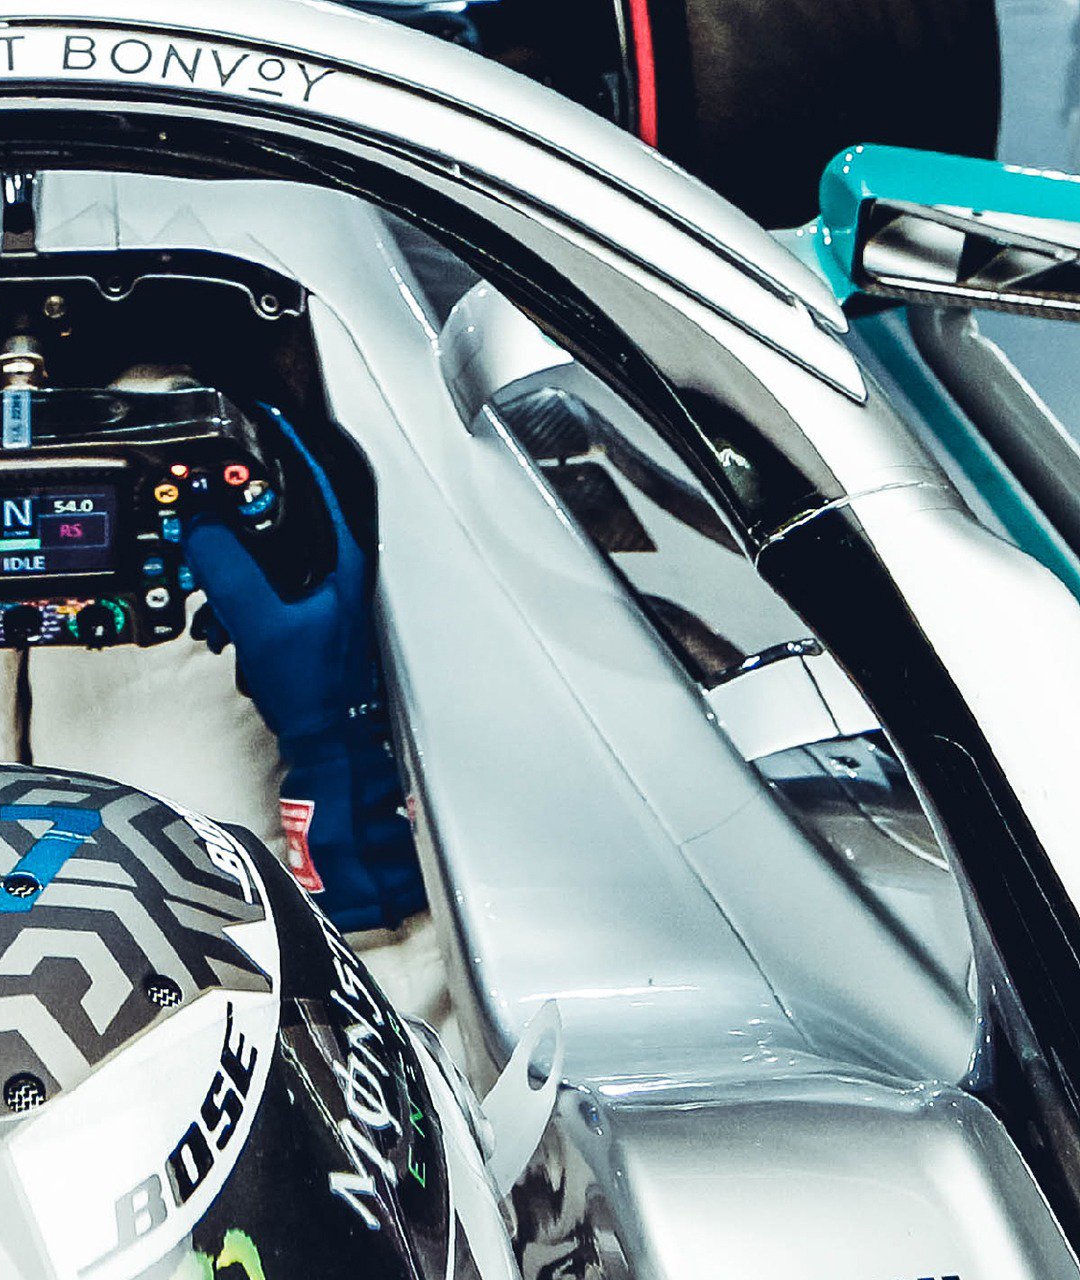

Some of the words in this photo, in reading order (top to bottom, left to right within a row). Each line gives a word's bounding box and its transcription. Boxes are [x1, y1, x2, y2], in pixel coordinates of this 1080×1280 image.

[3, 498, 33, 527] N
[53, 499, 94, 514] 54.0
[2, 555, 46, 571] IDLE
[76, 1000, 258, 1280] BOSE
